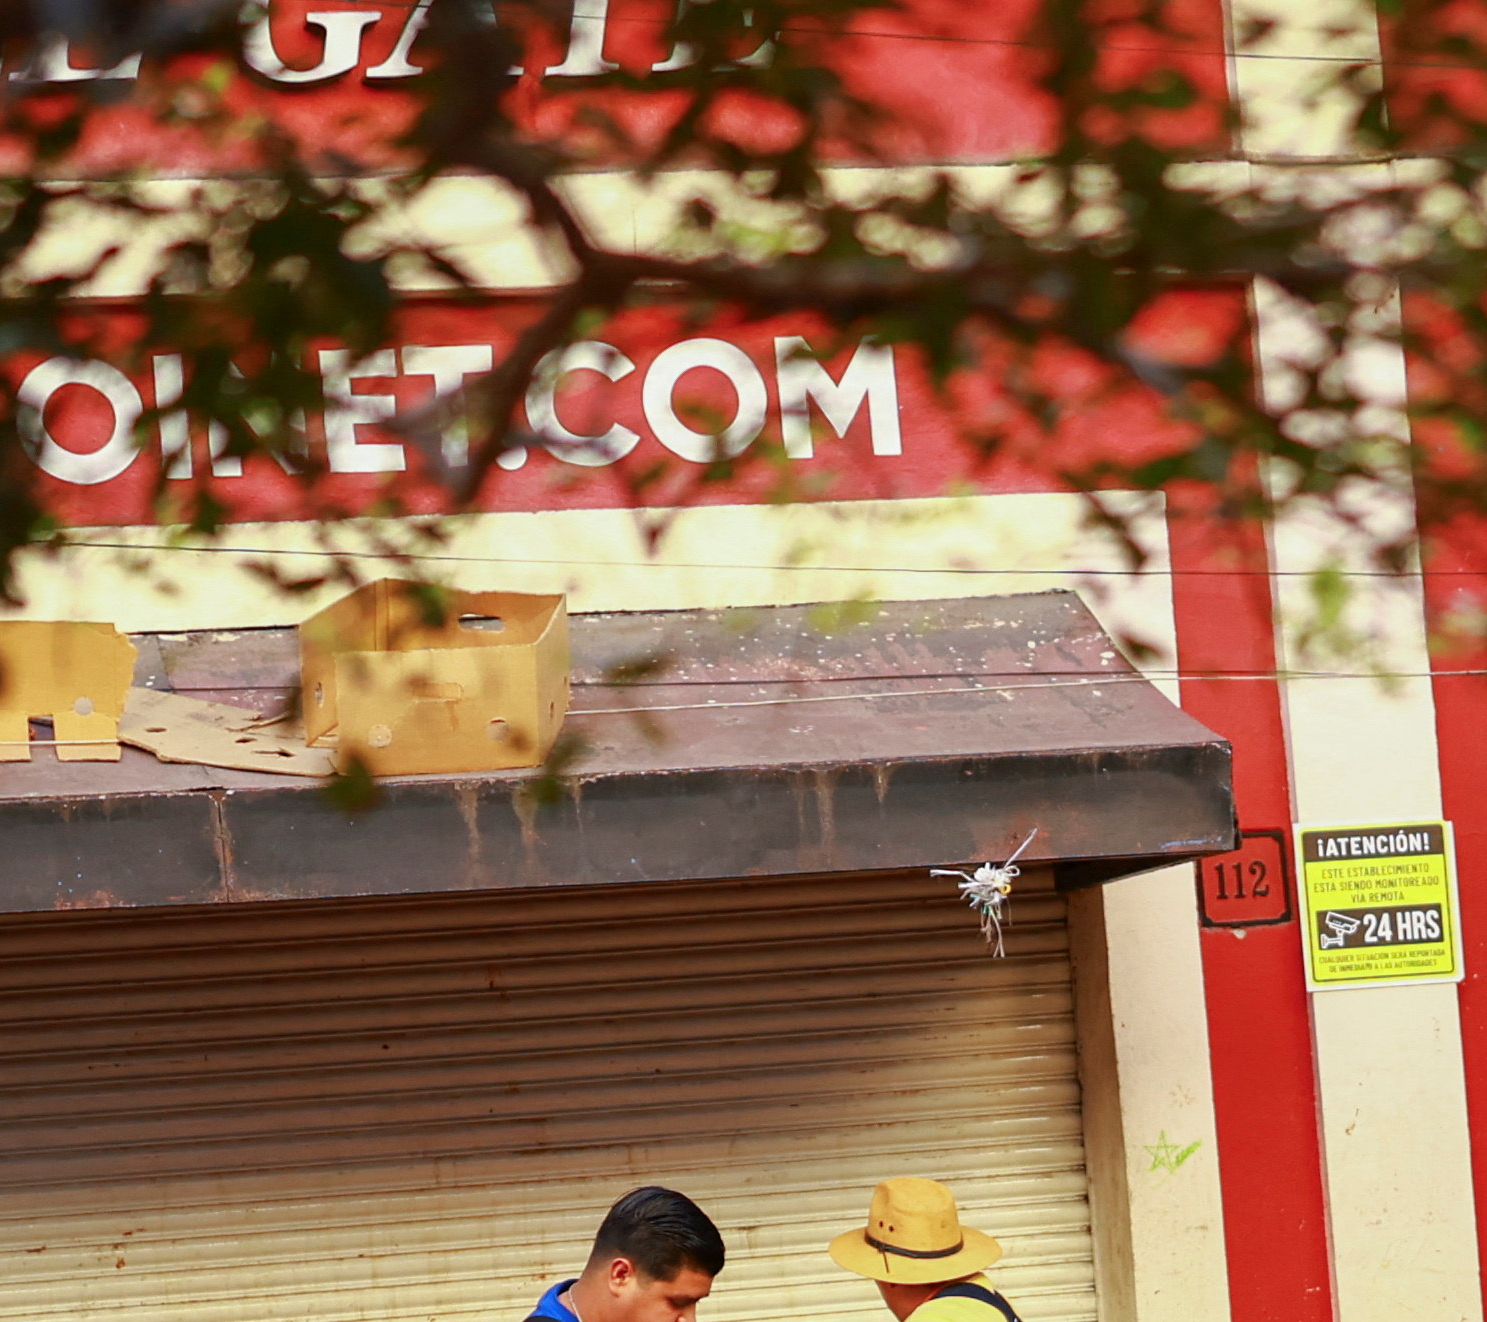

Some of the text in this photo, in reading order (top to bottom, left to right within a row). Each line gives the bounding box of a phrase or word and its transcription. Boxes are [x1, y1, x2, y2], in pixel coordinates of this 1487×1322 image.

[1317, 829, 1431, 858] ¡ATENCIÓN!
[1215, 860, 1270, 900] 112
[1321, 862, 1430, 880] ESTE ESTABLECIMIENTO
[1339, 878, 1373, 892] SIENDO
[1374, 875, 1440, 890] MONITOREADO
[1368, 890, 1405, 903] REMOTA
[1362, 908, 1442, 943] 24 HRS
